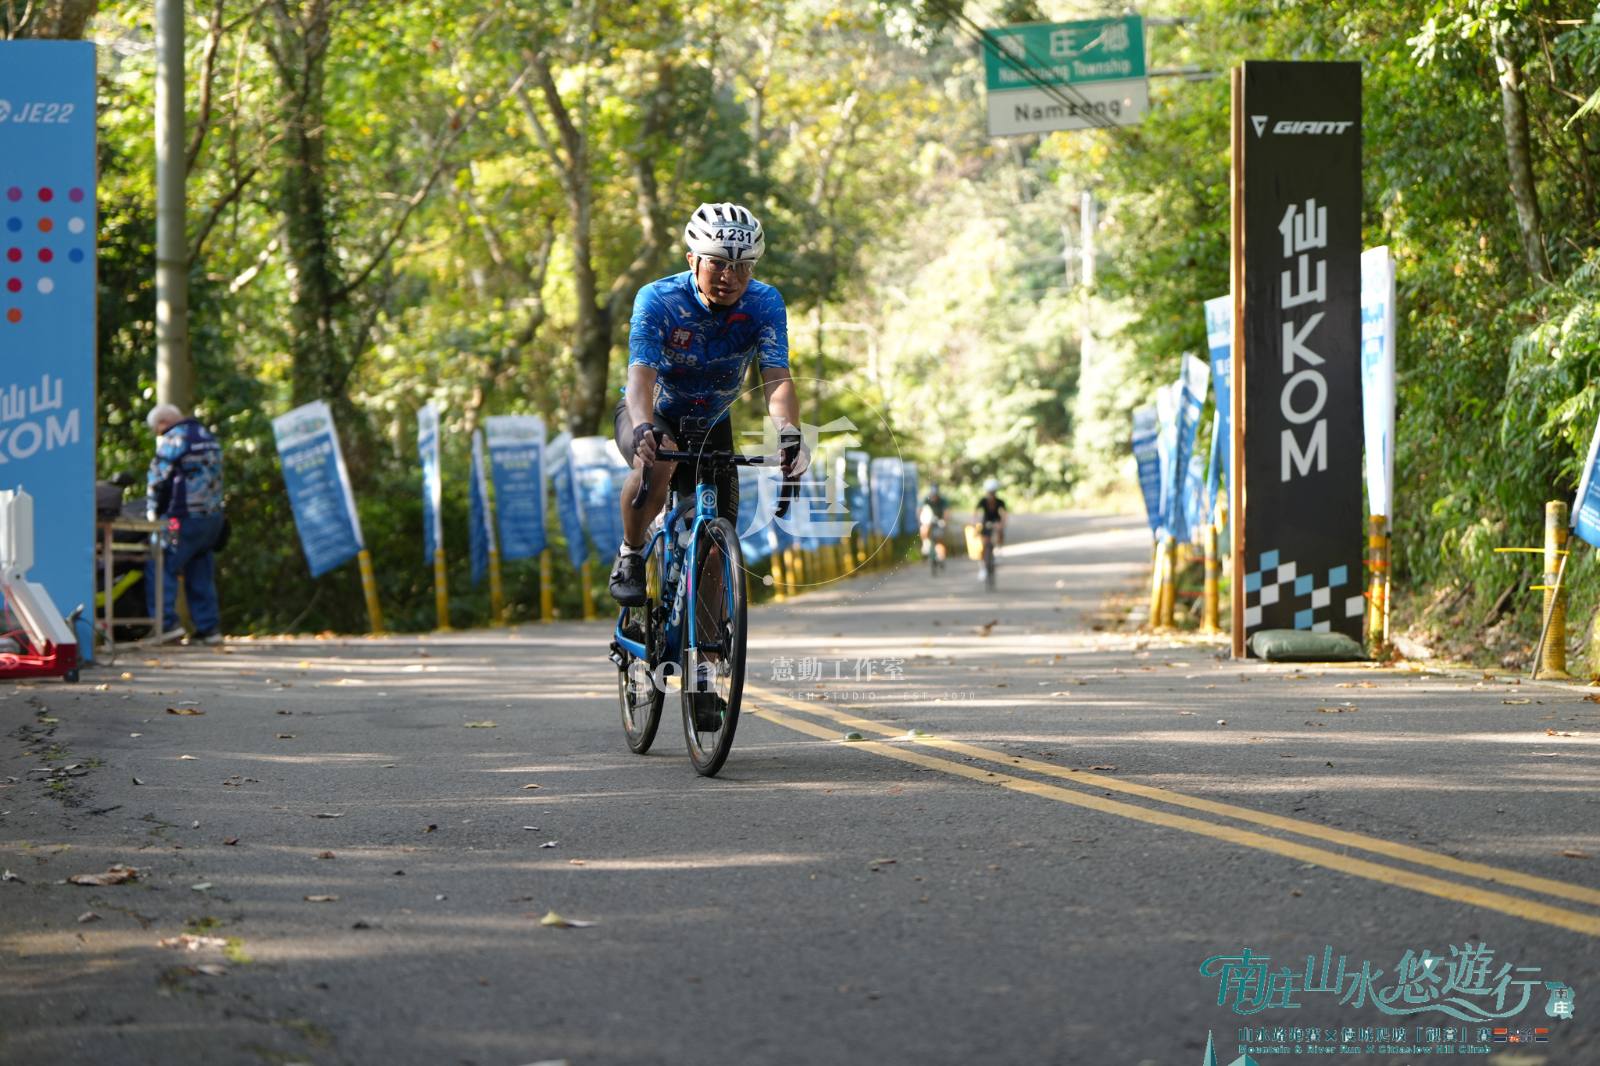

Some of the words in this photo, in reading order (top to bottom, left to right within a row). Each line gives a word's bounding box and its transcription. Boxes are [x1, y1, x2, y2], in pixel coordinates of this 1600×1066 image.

[1072, 60, 1131, 77] Township
[13, 102, 75, 123] JE22
[1272, 121, 1354, 134] GIANT
